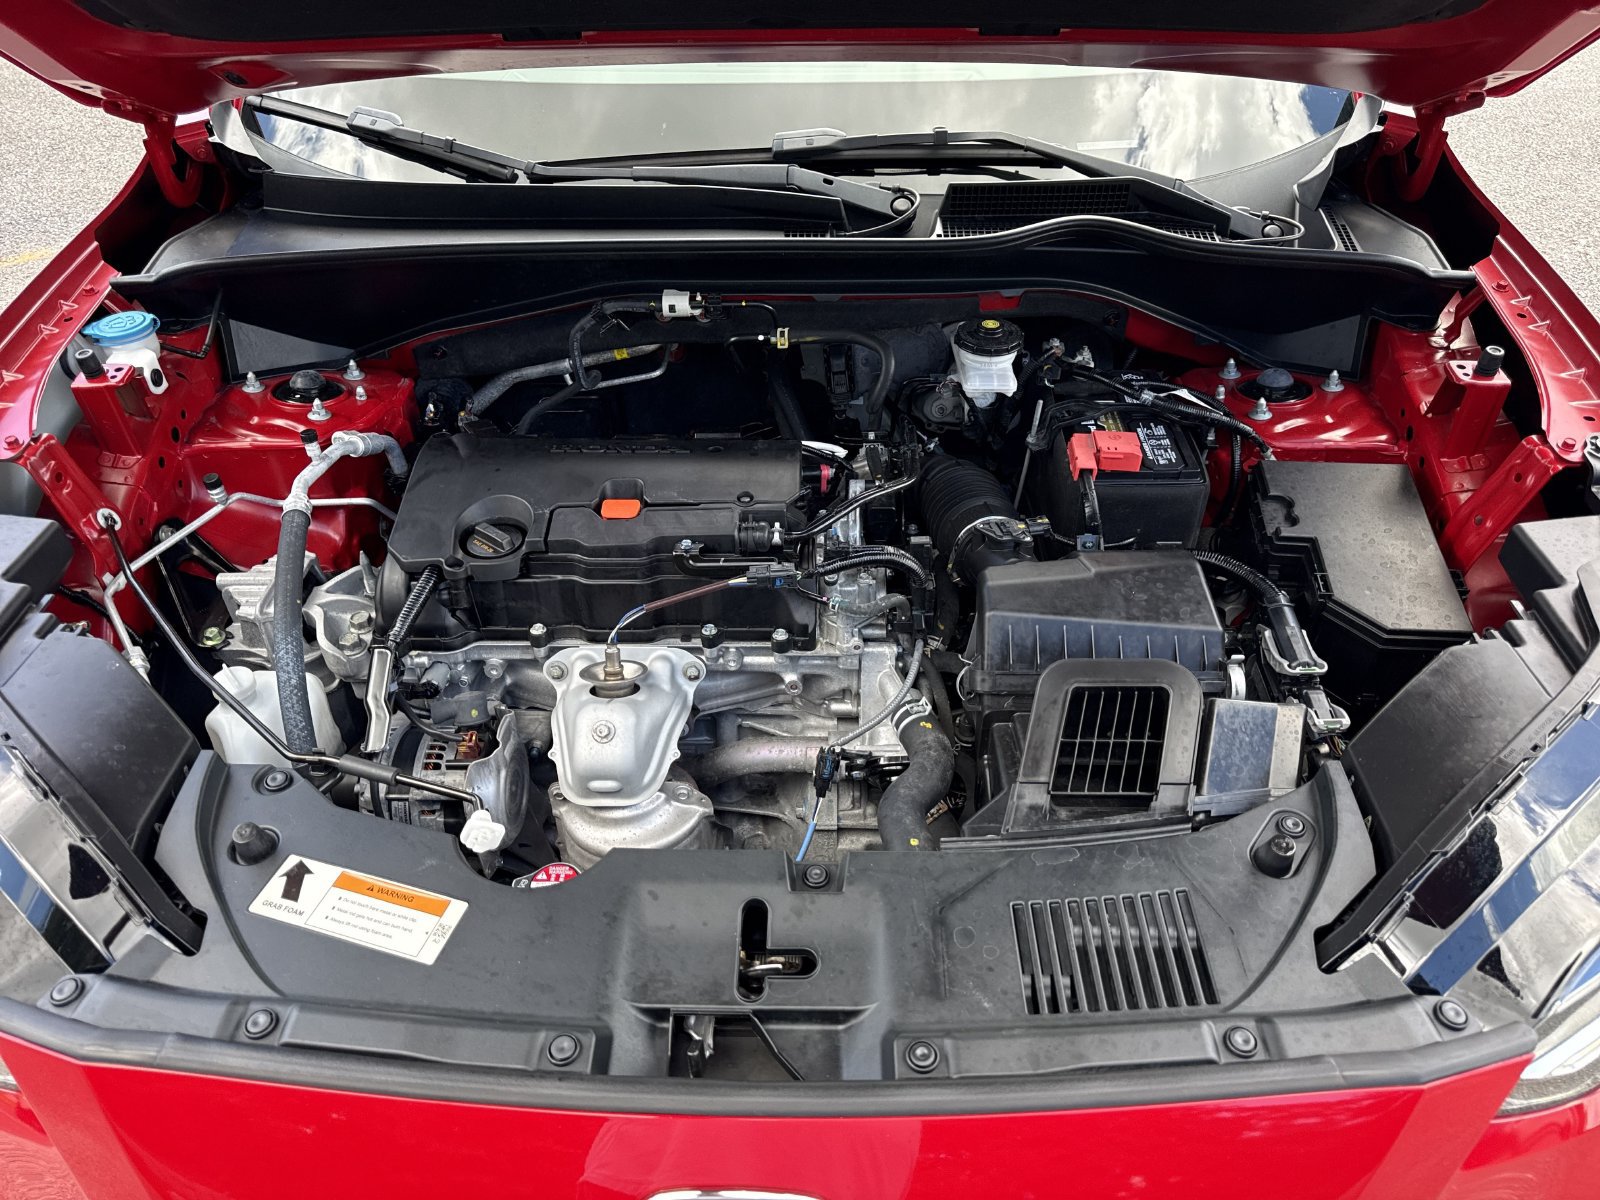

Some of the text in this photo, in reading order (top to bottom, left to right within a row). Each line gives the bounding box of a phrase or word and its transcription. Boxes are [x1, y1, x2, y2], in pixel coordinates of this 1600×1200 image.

[377, 887, 414, 903] WARNING
[262, 900, 305, 917] GRAB FOAM
